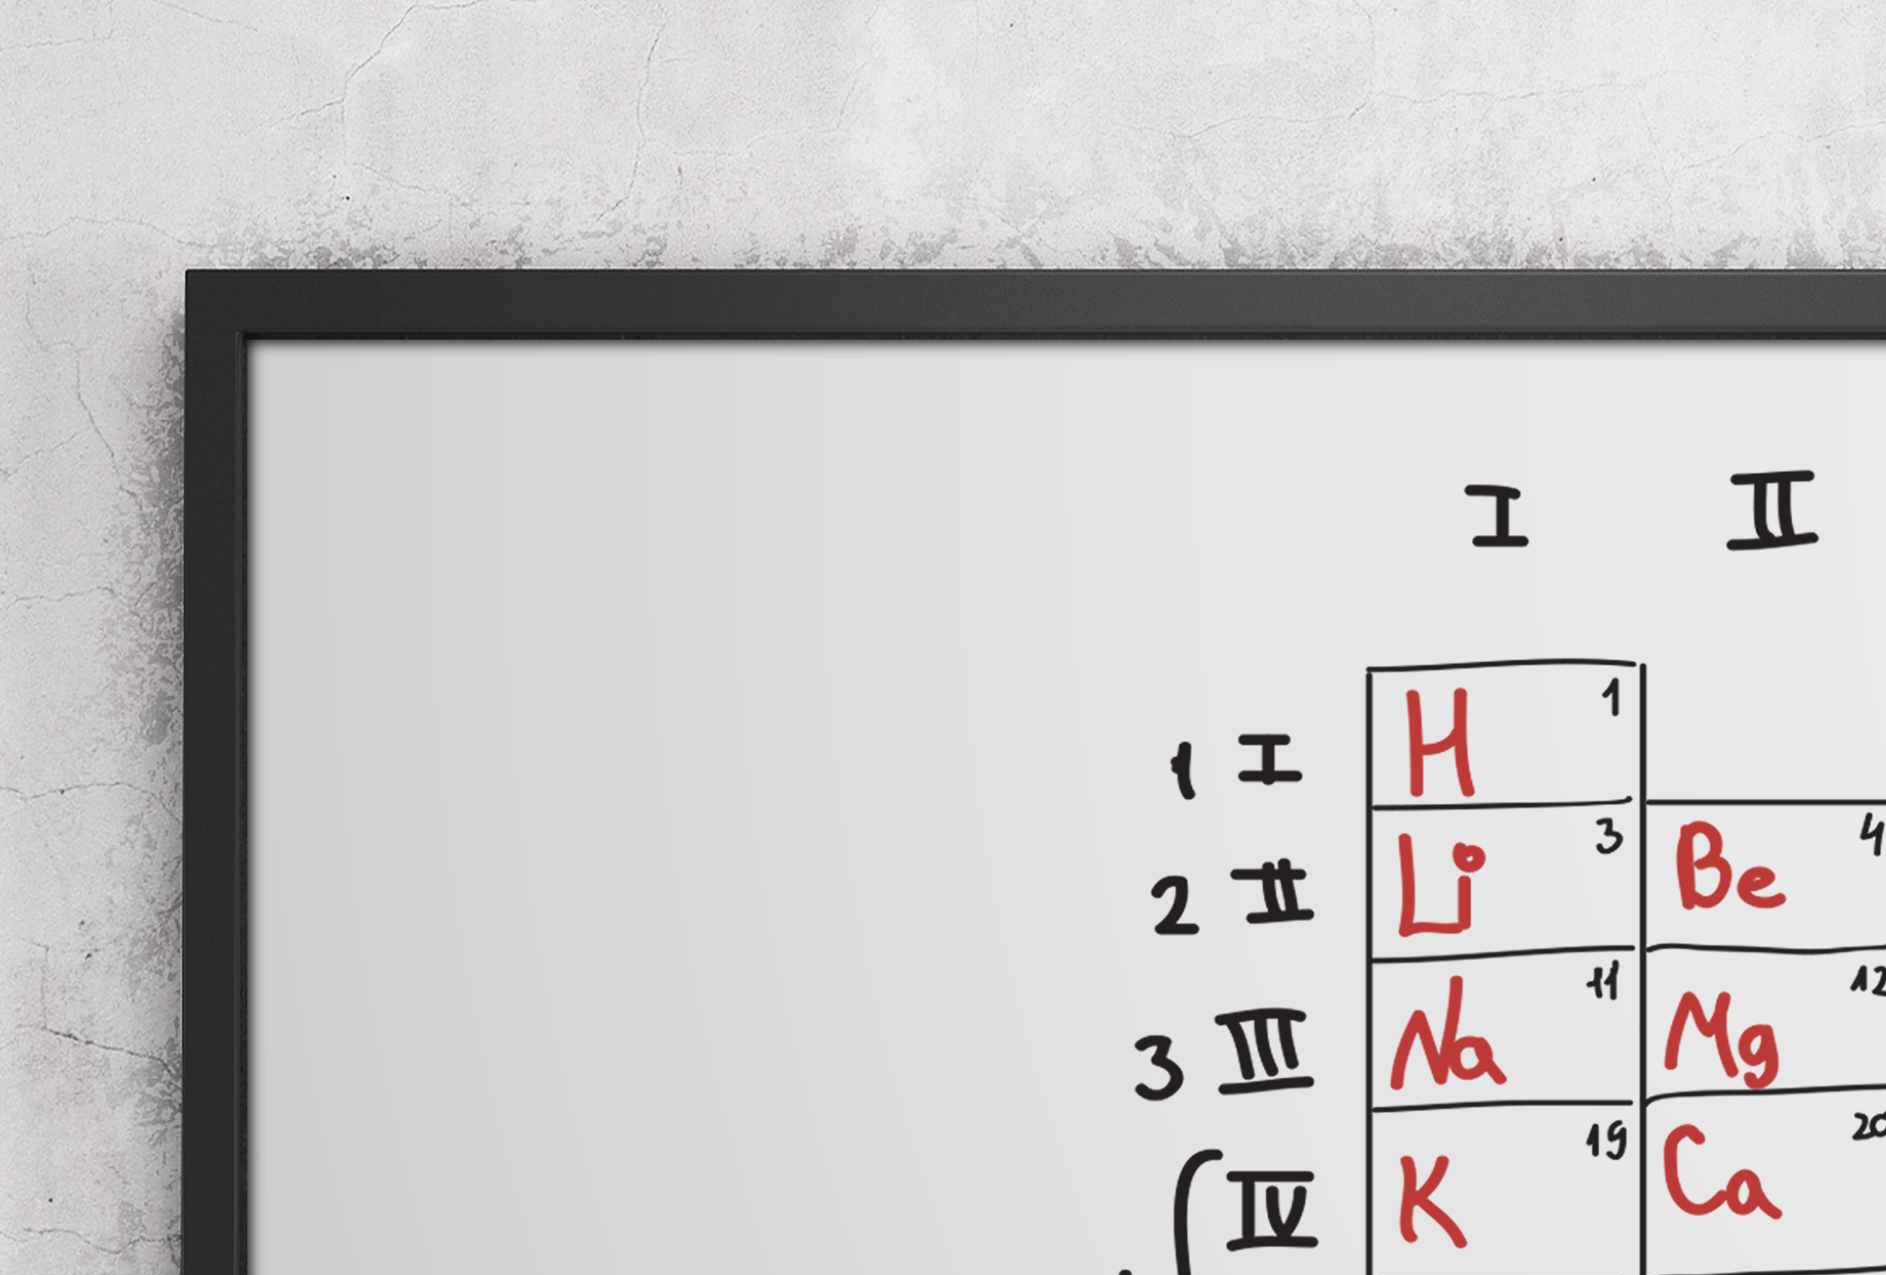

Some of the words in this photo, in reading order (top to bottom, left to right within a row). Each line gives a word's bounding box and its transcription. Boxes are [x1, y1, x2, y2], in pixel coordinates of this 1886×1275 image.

[1464, 484, 1529, 547] I
[1726, 470, 1819, 551] II
[1170, 741, 1196, 800] 1
[1238, 734, 1303, 786] I
[1406, 687, 1475, 797] H
[1601, 677, 1619, 717] 1
[1150, 875, 1200, 935] 2
[1230, 858, 1315, 924] II
[1398, 833, 1486, 938] Li
[1596, 817, 1624, 855] 3
[1676, 820, 1786, 910] Be
[1860, 812, 1885, 857] 4
[1134, 1035, 1184, 1101] 3
[1214, 1007, 1315, 1095] III
[1390, 975, 1508, 1090] Na
[1586, 959, 1619, 1001] 11
[1663, 991, 1779, 1092] Mg
[1226, 1170, 1319, 1252] IV
[1399, 1155, 1467, 1249] K
[1586, 1119, 1627, 1161] 19
[1663, 1123, 1783, 1220] Ca
